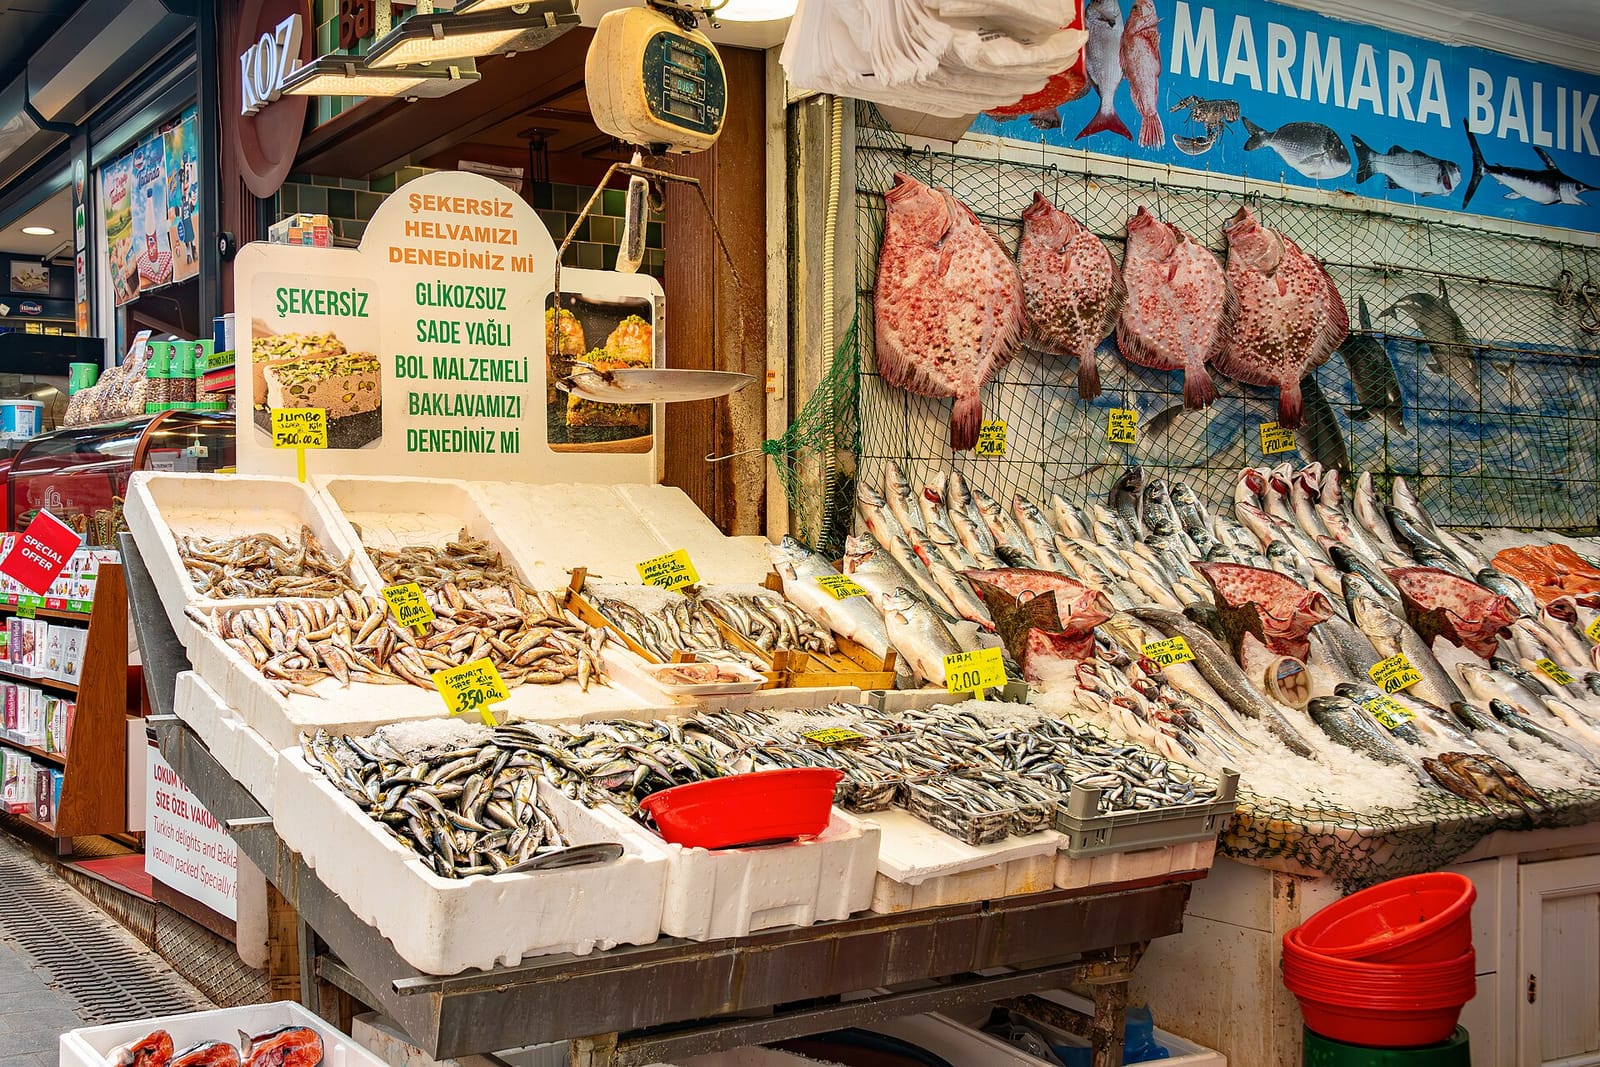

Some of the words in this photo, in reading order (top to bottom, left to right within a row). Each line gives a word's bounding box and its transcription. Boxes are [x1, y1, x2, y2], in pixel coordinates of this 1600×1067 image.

[240, 13, 303, 117] KOZ
[1170, 1, 1451, 128] MARMARA
[1468, 67, 1600, 157] BALIK
[408, 192, 514, 219] ŞEKERSİZ
[404, 220, 518, 246] HELVAMIZI
[388, 246, 505, 271] DENEDİNİZ
[511, 253, 534, 273] Mİ
[276, 287, 369, 318] ŞEKERSİZ
[415, 280, 507, 311] GLİKOZSUZ
[416, 318, 461, 345] SADE
[465, 318, 511, 347] YAĞLI
[395, 354, 428, 379] BOL
[433, 356, 529, 383] MALZEMELİ
[277, 411, 321, 422] JUMBO
[408, 391, 521, 419] BAKLAVAMIZI
[406, 426, 496, 453] DENEDİNİZ
[500, 427, 520, 454] Mİ
[21, 547, 54, 571] OFFER
[23, 534, 63, 565] SPECIAL
[153, 763, 177, 786] LOKUM
[155, 787, 171, 811] SİZE
[171, 793, 189, 819] ÖZEL
[190, 804, 219, 833] VAKUM
[153, 815, 175, 838] Turkish
[175, 821, 202, 853] delights
[202, 841, 216, 860] and
[152, 845, 175, 868] vacuum
[175, 854, 200, 881] packed
[200, 866, 232, 901] Specially
